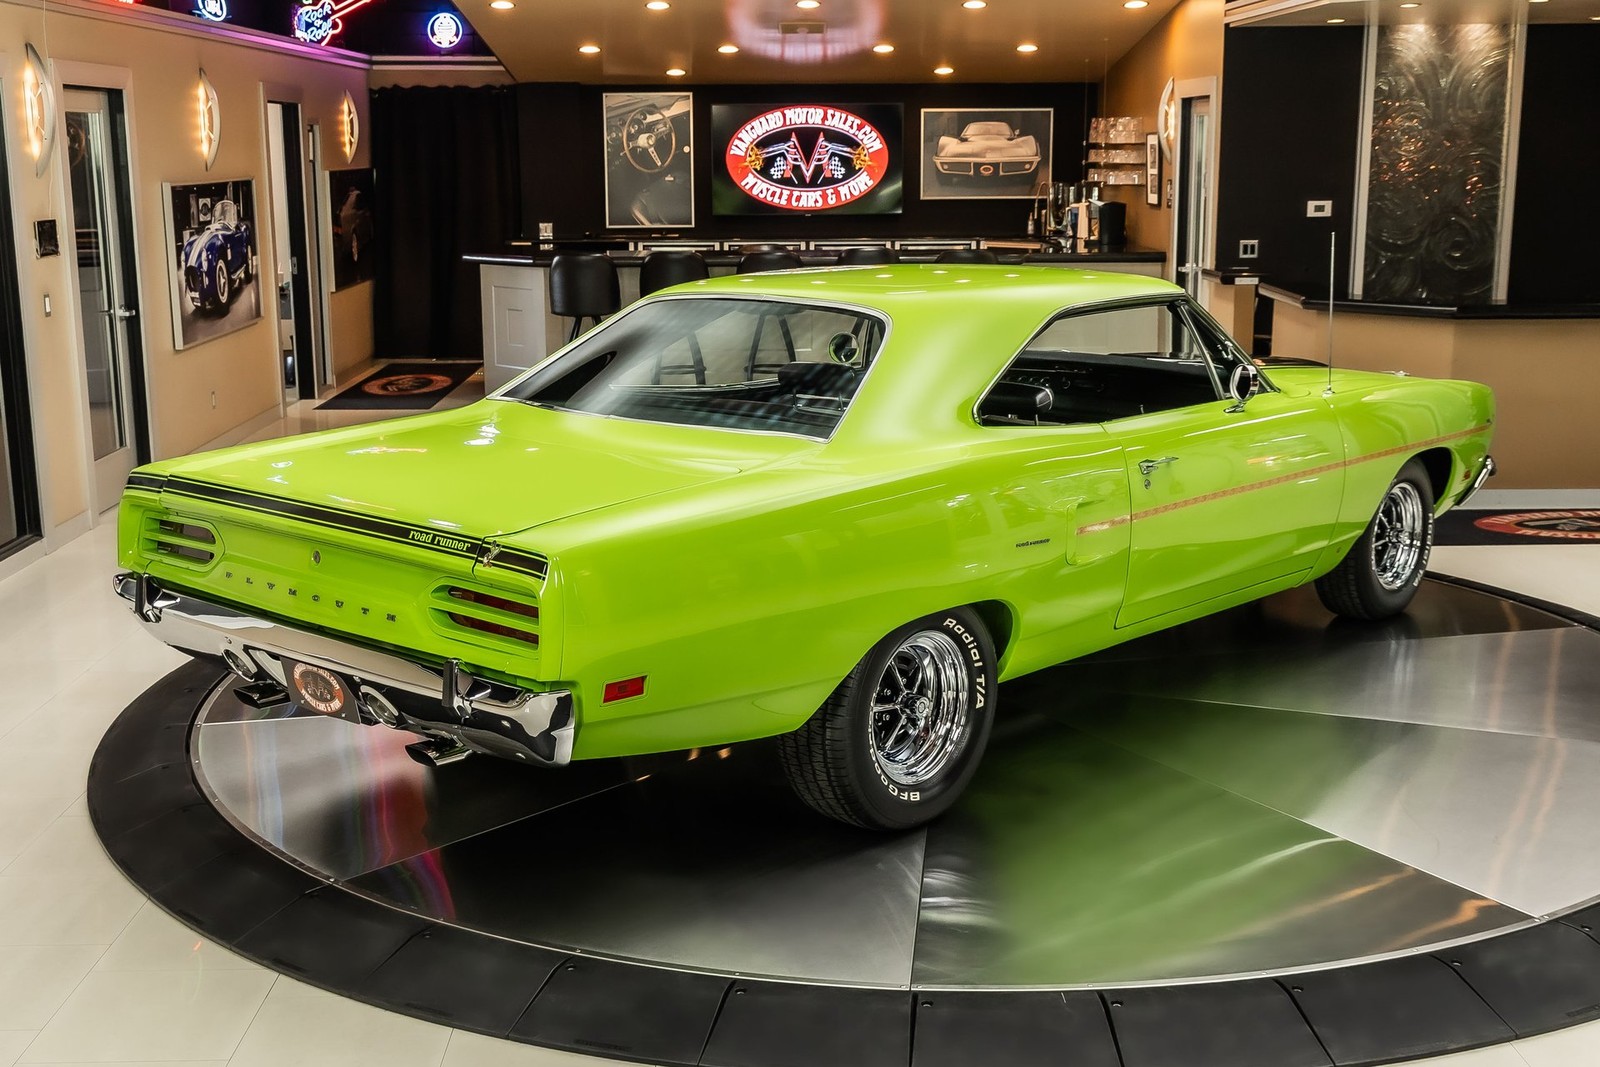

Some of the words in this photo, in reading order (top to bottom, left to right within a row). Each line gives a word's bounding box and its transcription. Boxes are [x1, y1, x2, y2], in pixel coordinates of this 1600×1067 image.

[302, 2, 332, 23] Rock
[307, 19, 332, 42] Roll
[730, 110, 784, 157] VANGUARD
[784, 107, 824, 126] MOTOR
[824, 109, 883, 153] SALES.COM
[740, 173, 790, 207] MUSCLE
[791, 191, 823, 208] CARS
[826, 189, 836, 205] &
[837, 171, 874, 202] MORE
[408, 530, 433, 543] road
[434, 536, 471, 551] runner
[225, 571, 397, 622] PLYMOUTH
[943, 617, 983, 667] Radial
[975, 673, 986, 709] T/A
